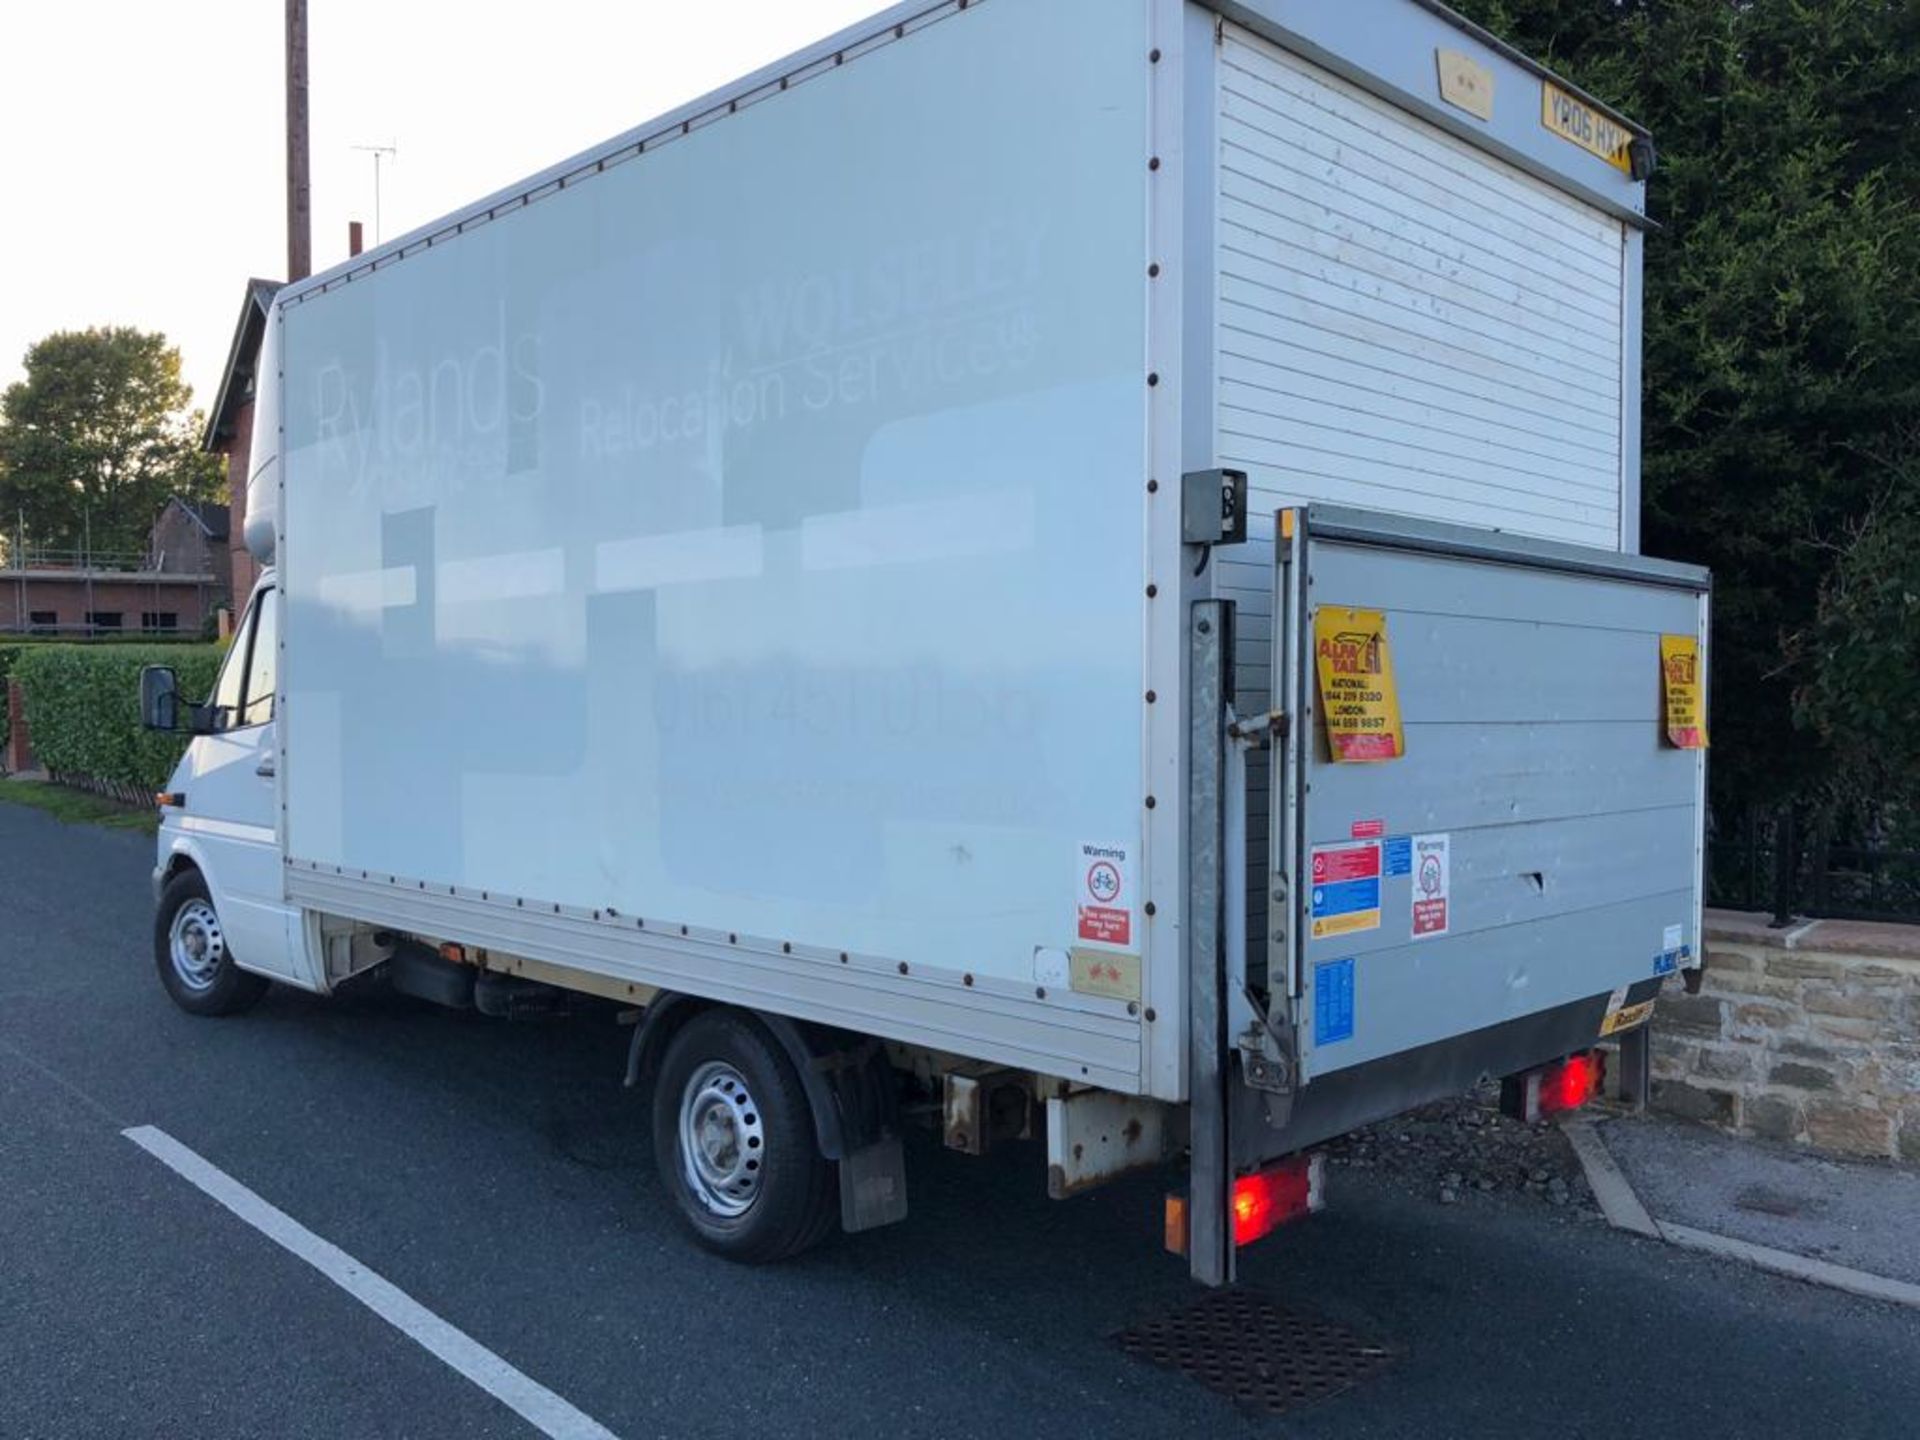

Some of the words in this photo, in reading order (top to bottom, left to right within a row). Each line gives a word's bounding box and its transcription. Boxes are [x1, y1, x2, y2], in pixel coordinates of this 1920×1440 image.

[1552, 92, 1592, 143] YR06
[313, 302, 545, 496] Rylands
[1083, 845, 1126, 862] Warning
